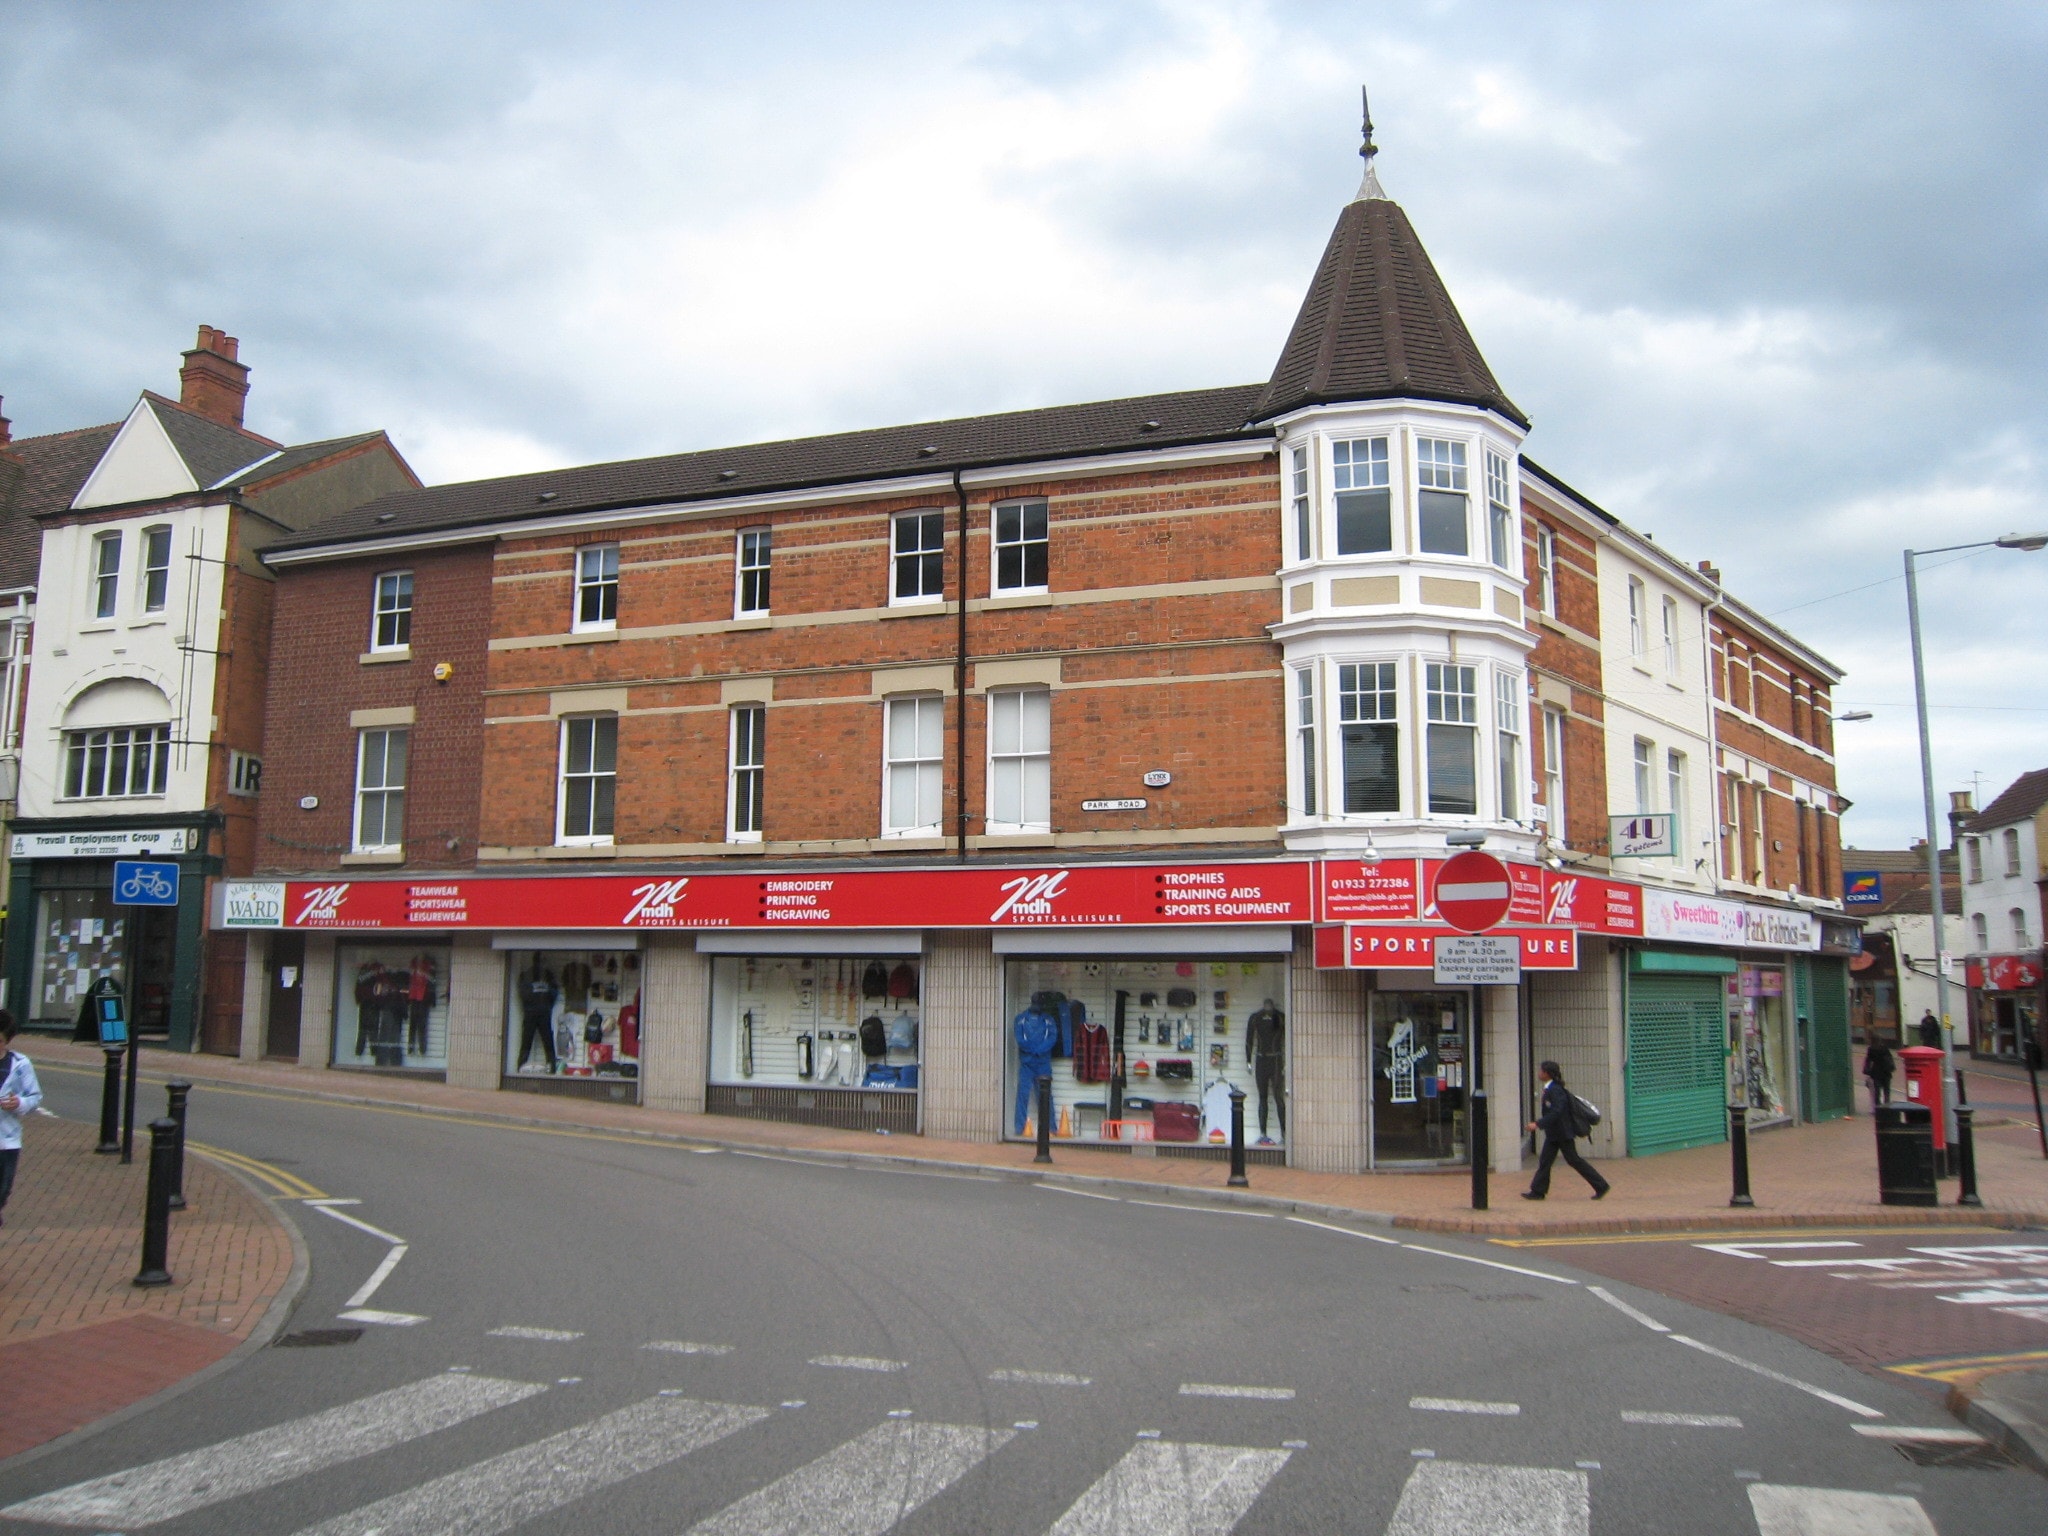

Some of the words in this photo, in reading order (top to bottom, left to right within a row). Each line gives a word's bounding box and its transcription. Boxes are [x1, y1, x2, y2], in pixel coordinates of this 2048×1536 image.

[1087, 801, 1109, 809] PARK
[1619, 818, 1664, 839] 4U
[36, 836, 66, 845] Travail
[69, 834, 127, 845] Employment
[132, 832, 160, 843] Group
[1623, 839, 1663, 855] Systems
[1360, 867, 1380, 877] Tel:
[1164, 872, 1225, 885] TROPHIES
[1331, 879, 1366, 889] 01933
[1368, 878, 1410, 889] 272386
[410, 886, 459, 896] TEAMWEAR
[766, 880, 834, 892] EMBROIDERY
[1164, 888, 1227, 900] TRAINING
[1230, 887, 1261, 899] AIDS
[1846, 894, 1880, 902] CORAL
[410, 899, 467, 909] SPORTSWEAR
[766, 895, 817, 906] PRINTING
[1012, 898, 1051, 915] mdh
[230, 900, 280, 918] WARD
[310, 906, 336, 919] mdh
[641, 904, 674, 918] mdh
[766, 908, 831, 920] ENGRAVING
[1164, 903, 1211, 916] SPORTS
[1214, 902, 1291, 916] EQUIPMENT
[1673, 900, 1719, 925] Sweetbitz
[409, 911, 468, 922] LEISUREWEAR
[1745, 910, 1766, 943] Park
[1767, 914, 1798, 945] Fabrics
[1354, 937, 1431, 952] SPORT
[1527, 939, 1569, 953] URE
[1458, 939, 1476, 947] Mon
[1481, 939, 1497, 947] Sat
[1493, 948, 1507, 956] pm
[1438, 956, 1466, 965] Except
[1468, 956, 1488, 964] local
[1440, 965, 1474, 973] hackney
[1475, 965, 1515, 973] carriages
[1472, 973, 1499, 981] cycles
